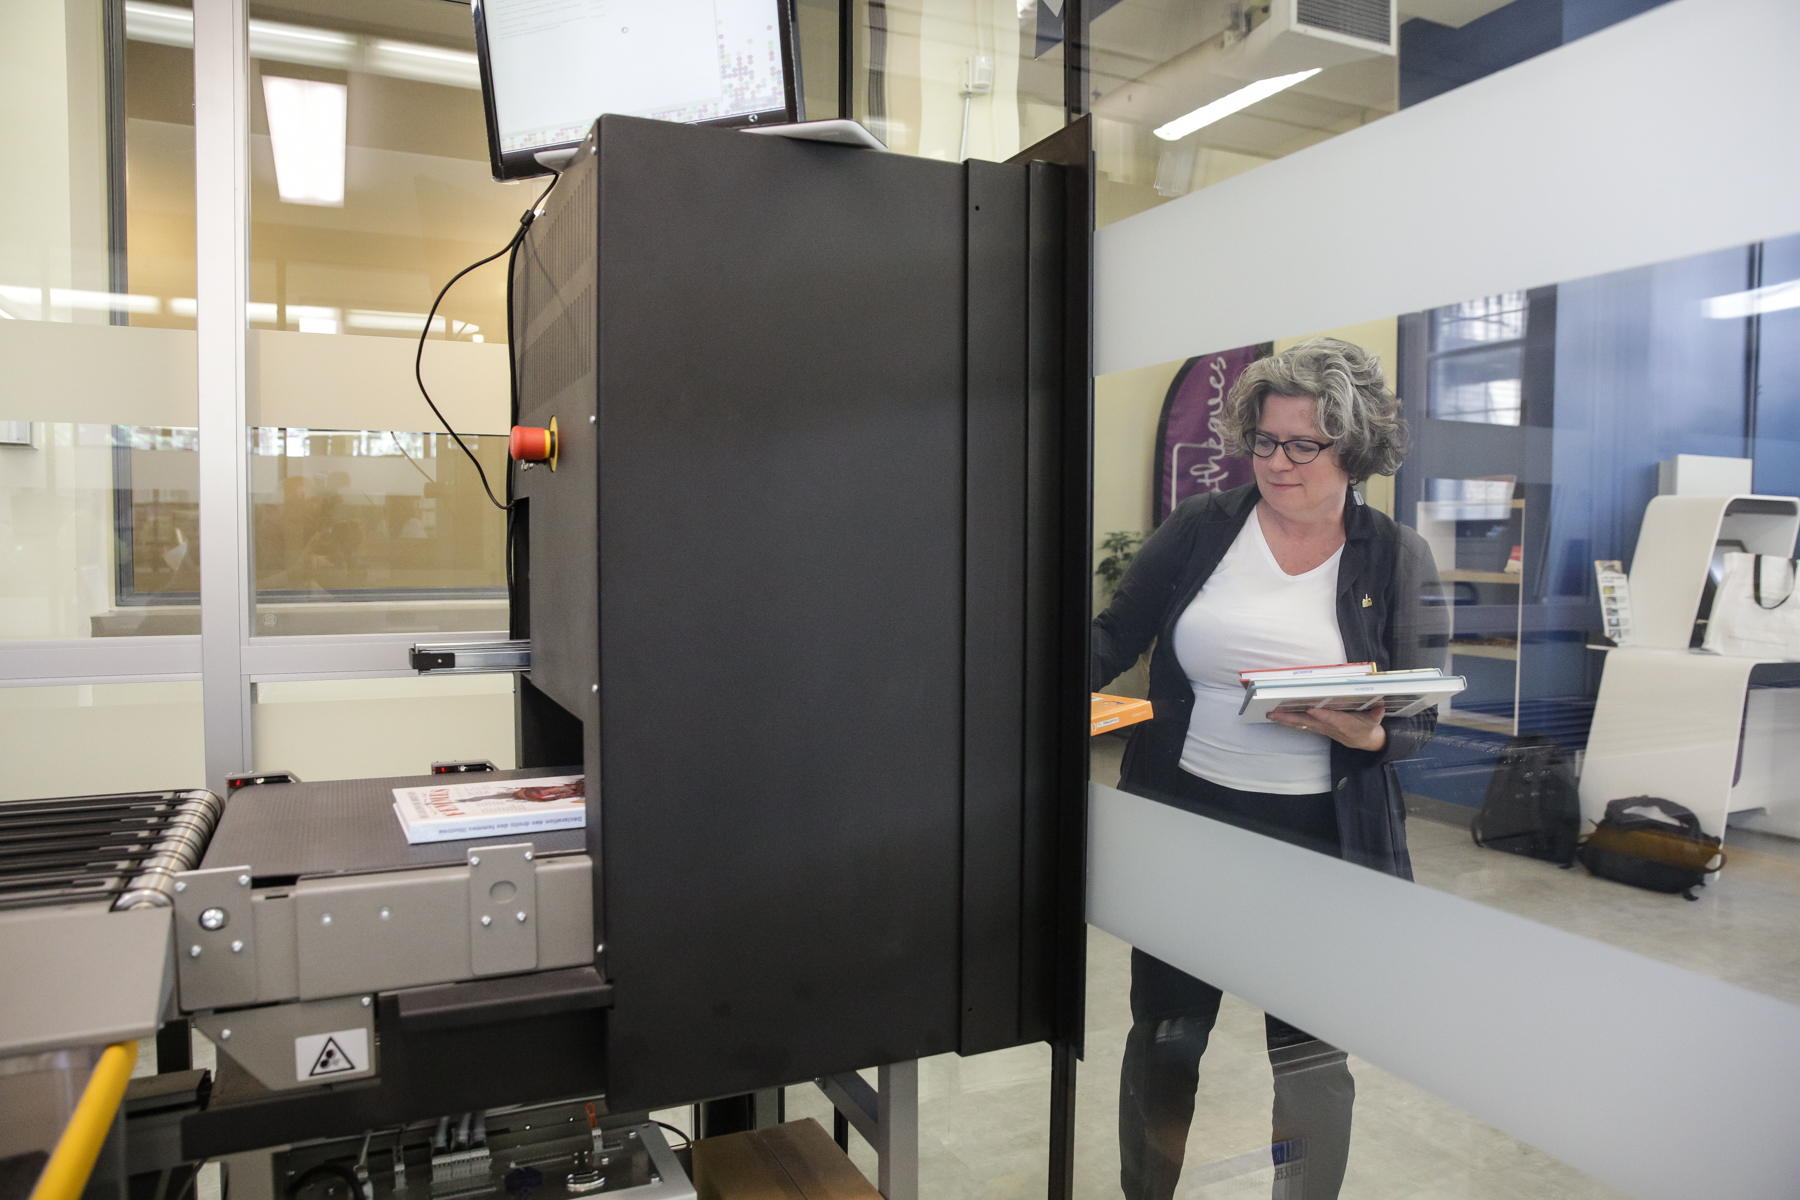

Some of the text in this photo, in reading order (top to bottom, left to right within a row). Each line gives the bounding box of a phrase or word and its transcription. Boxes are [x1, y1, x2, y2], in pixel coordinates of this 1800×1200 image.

[429, 788, 466, 817] FEMMES
[510, 821, 531, 829] droits
[545, 816, 583, 826] Déclaration
[468, 824, 496, 832] femmes
